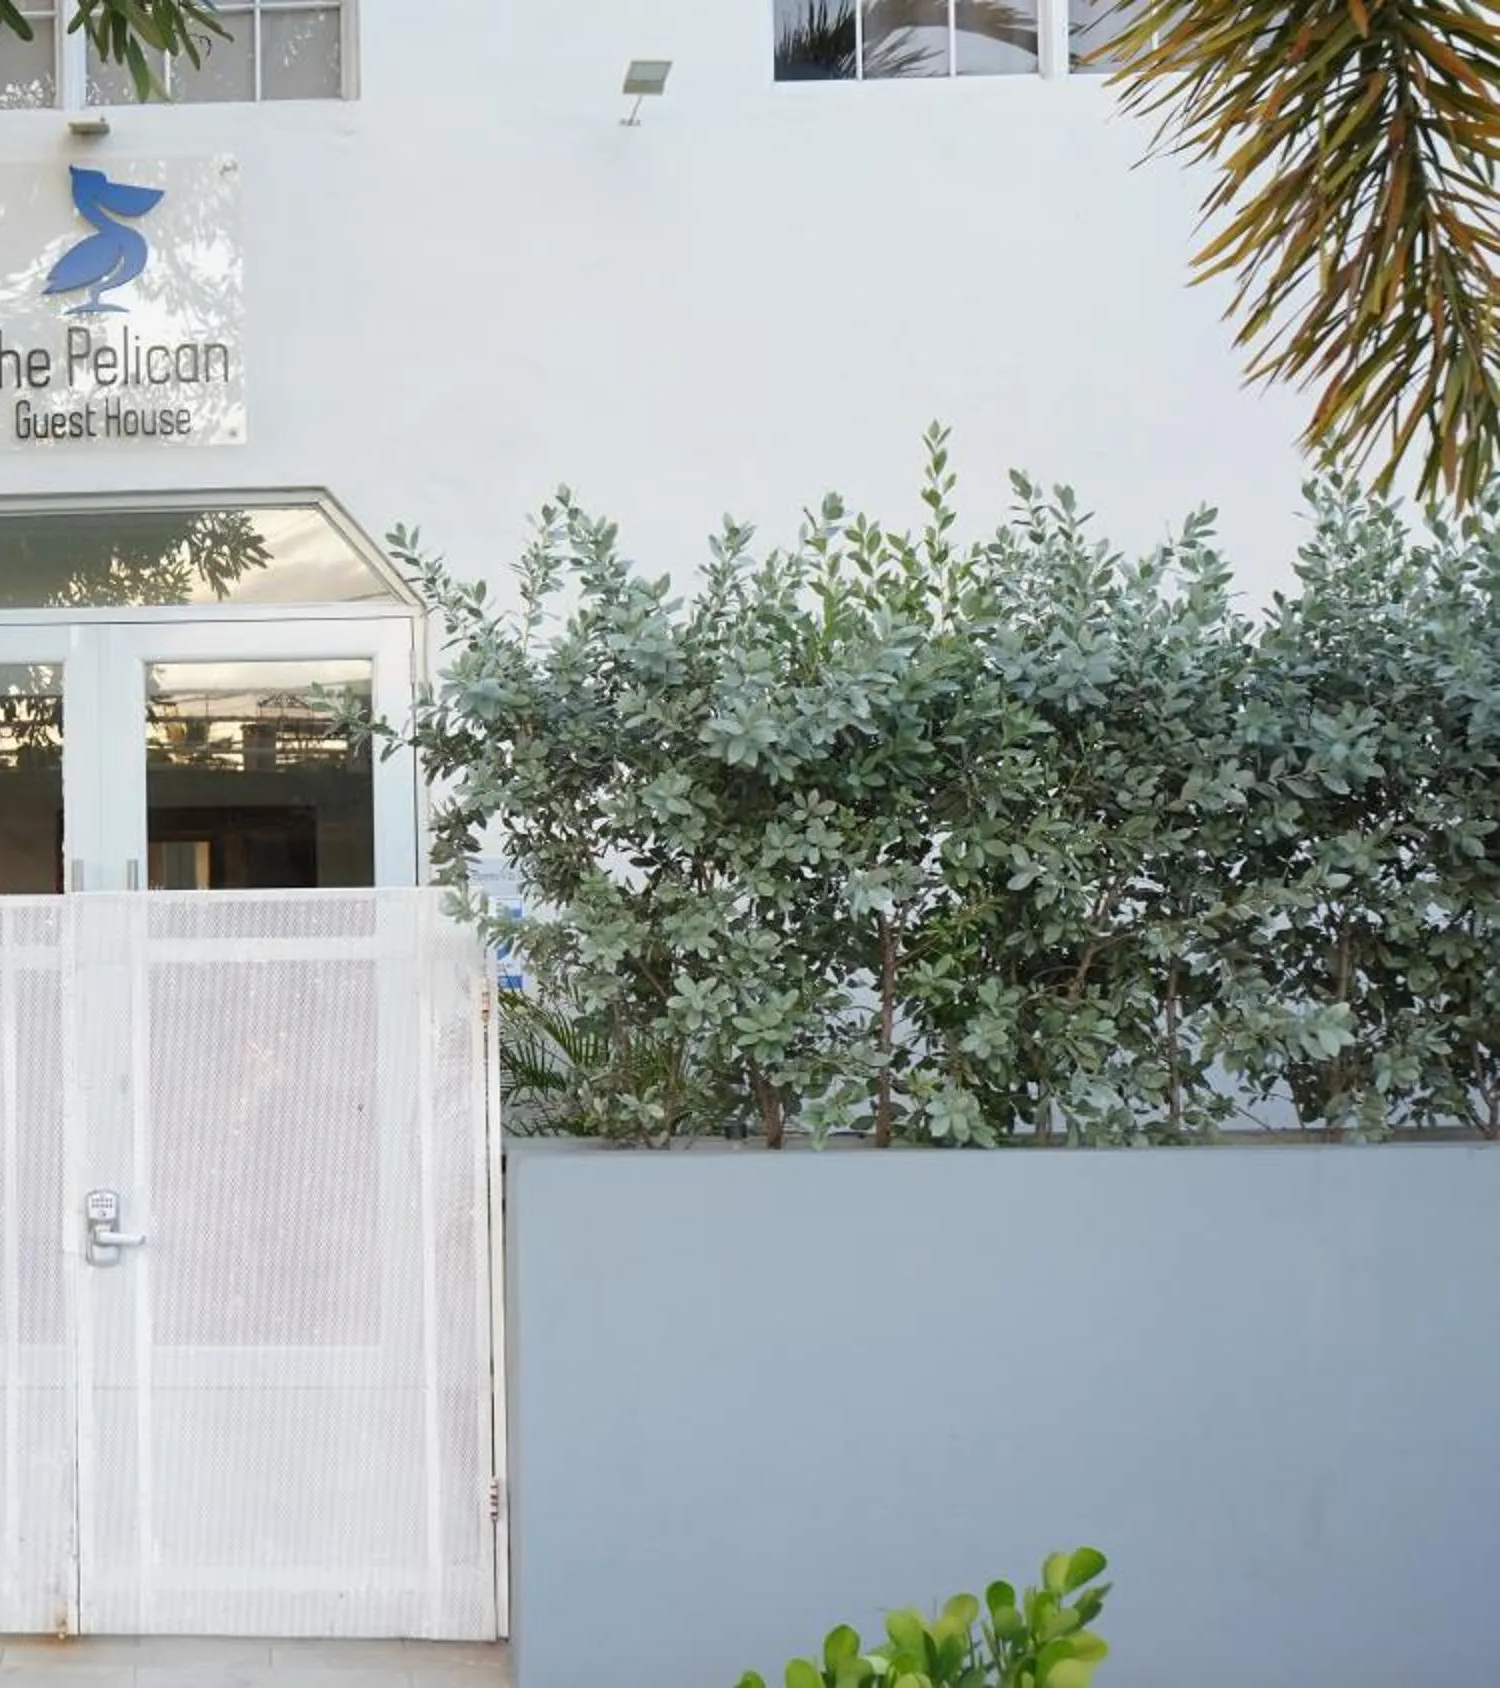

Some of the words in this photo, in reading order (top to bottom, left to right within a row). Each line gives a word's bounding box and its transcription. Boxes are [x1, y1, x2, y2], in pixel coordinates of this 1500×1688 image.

[67, 325, 230, 388] Pelican
[14, 399, 98, 439] Guest
[105, 397, 193, 438] House
